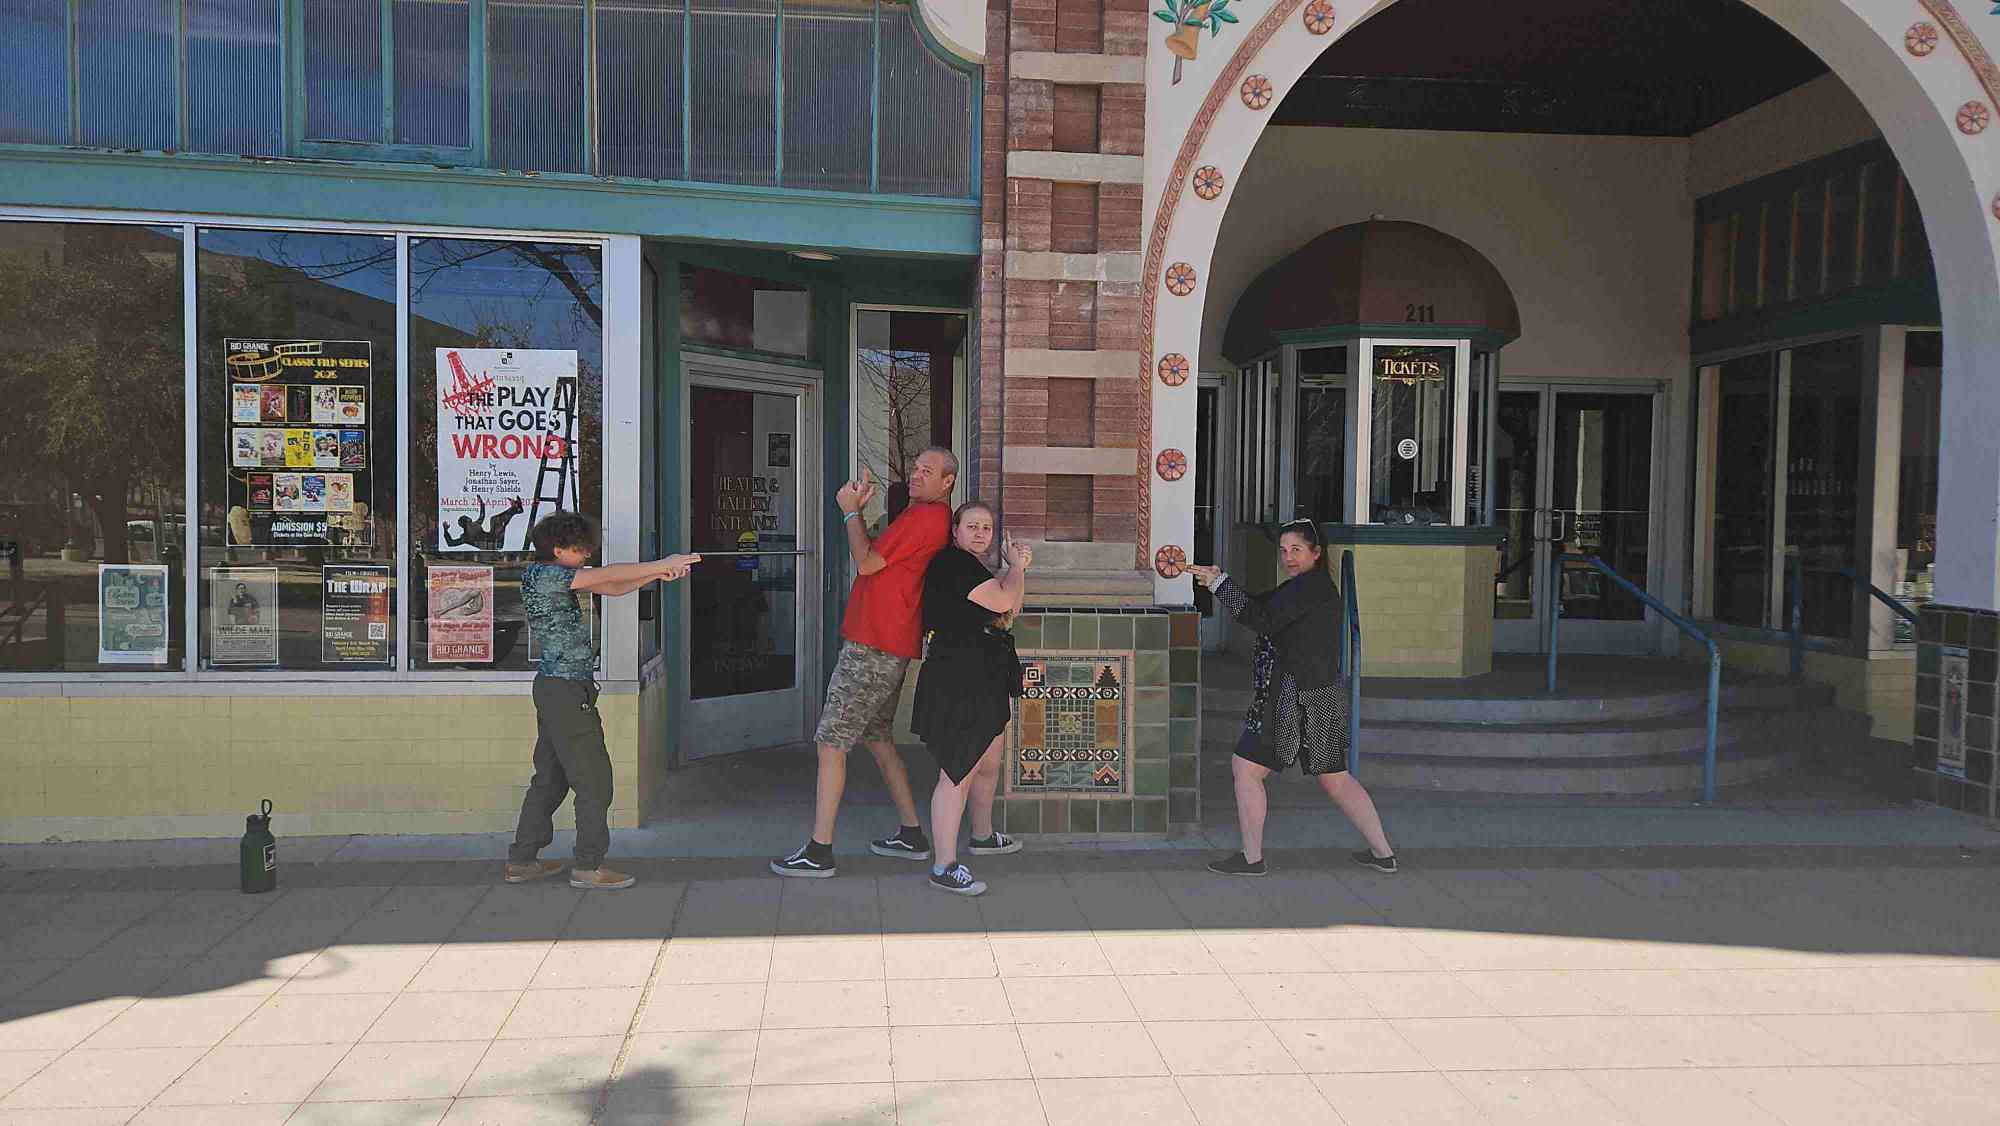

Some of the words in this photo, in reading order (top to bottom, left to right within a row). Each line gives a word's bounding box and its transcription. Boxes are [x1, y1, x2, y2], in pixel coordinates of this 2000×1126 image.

[1405, 304, 1434, 322] 211
[242, 342, 271, 351] GRANDE
[282, 358, 316, 367] CLASSIC
[317, 358, 337, 367] FILM
[338, 359, 369, 368] SERIES
[470, 393, 494, 407] THE
[497, 386, 551, 407] PLAY
[455, 415, 494, 430] THAT
[498, 409, 561, 431] GOES
[451, 433, 567, 459] WRONG
[469, 468, 492, 478] Henry
[493, 469, 517, 478] Lewis,
[465, 477, 497, 486] Jonathan
[462, 485, 469, 493] &
[471, 485, 494, 494] Henry
[495, 485, 521, 493] Shields
[440, 496, 469, 506] March
[271, 521, 315, 532] ADMISSION
[316, 521, 327, 532] $5
[326, 579, 349, 593] THE
[350, 580, 387, 593] WRAP
